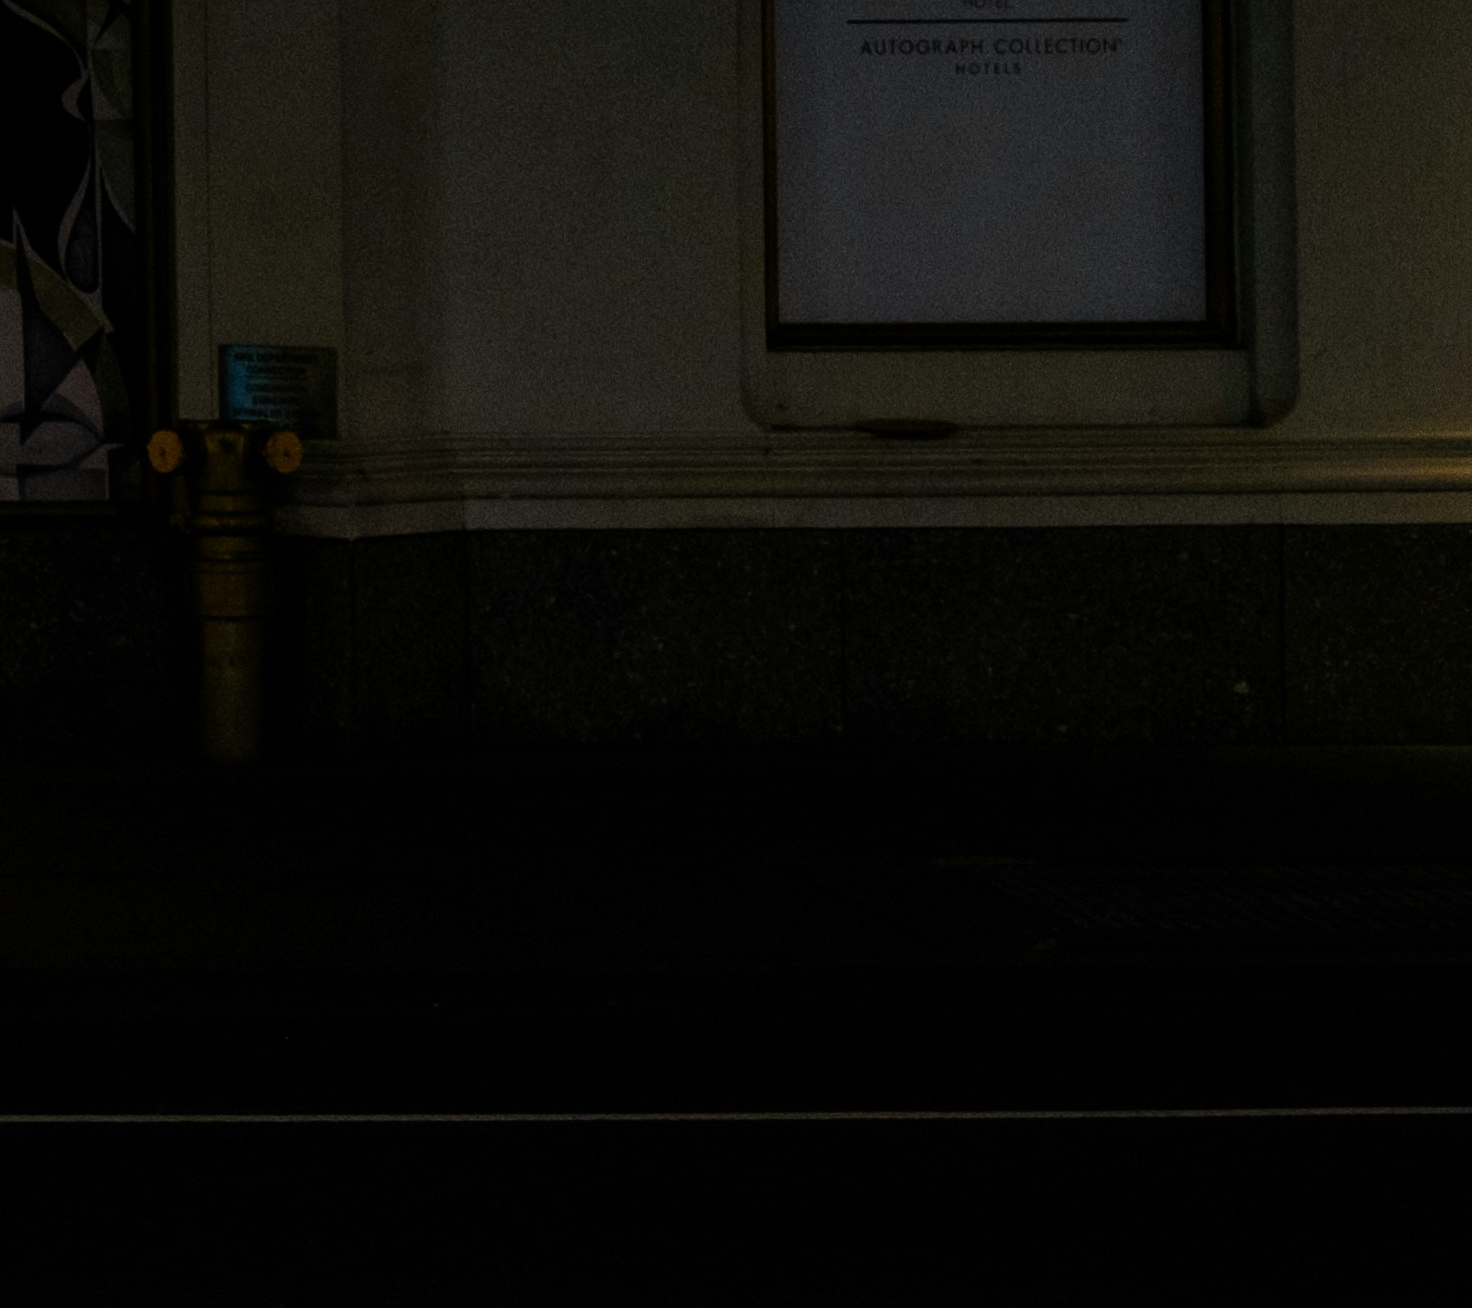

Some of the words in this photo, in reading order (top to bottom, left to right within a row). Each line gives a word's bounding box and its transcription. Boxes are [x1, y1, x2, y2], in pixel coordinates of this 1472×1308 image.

[860, 38, 984, 56] AUTOGRAPH
[993, 37, 1118, 55] COLLECTION
[955, 62, 1022, 76] HOTELS
